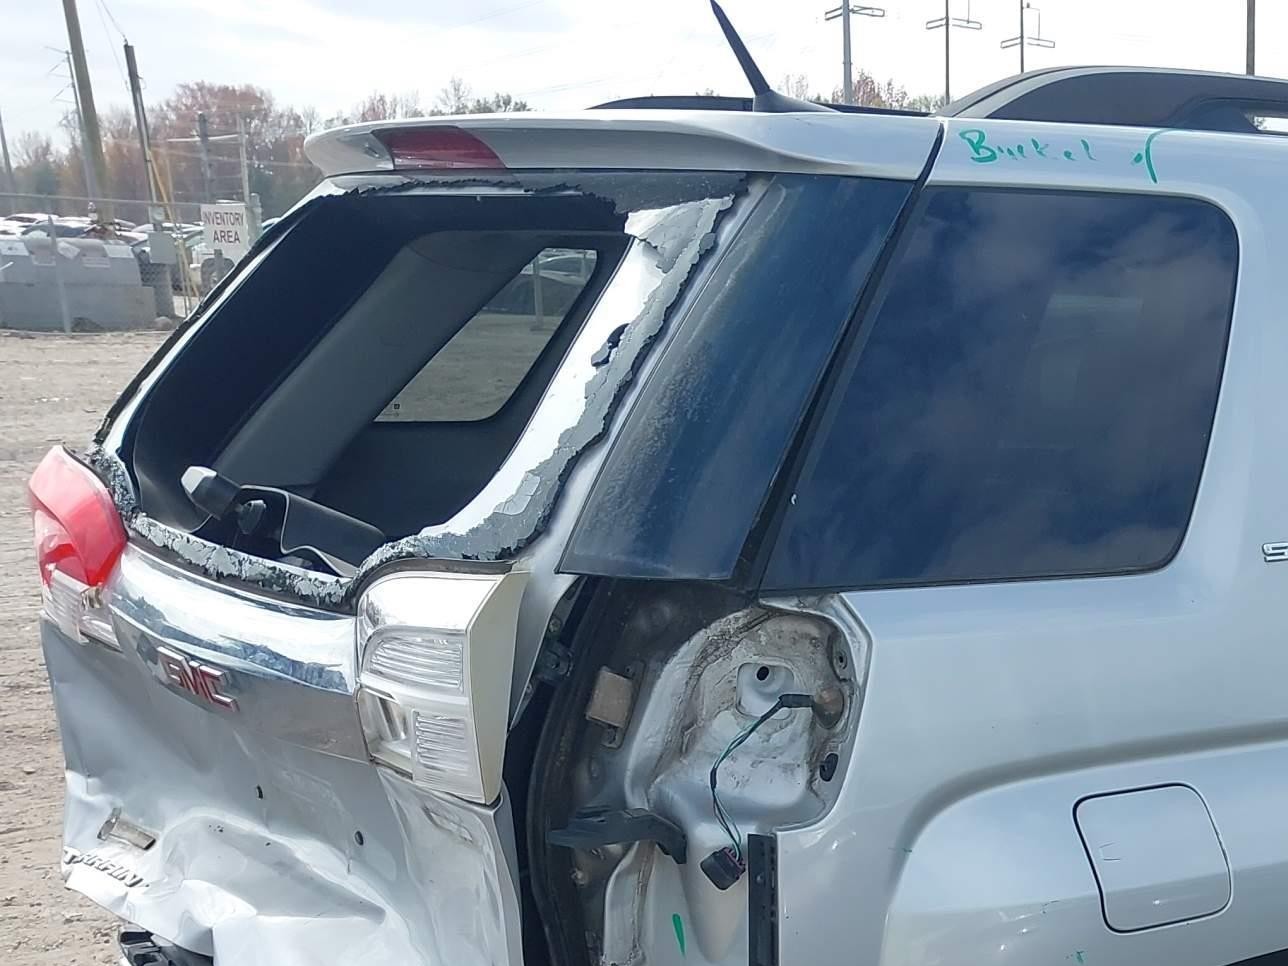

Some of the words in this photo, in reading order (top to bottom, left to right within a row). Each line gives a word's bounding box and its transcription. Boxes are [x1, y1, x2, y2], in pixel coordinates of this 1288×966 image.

[202, 211, 244, 226] INVENTORY
[213, 230, 241, 243] AREA
[157, 647, 240, 712] GMC
